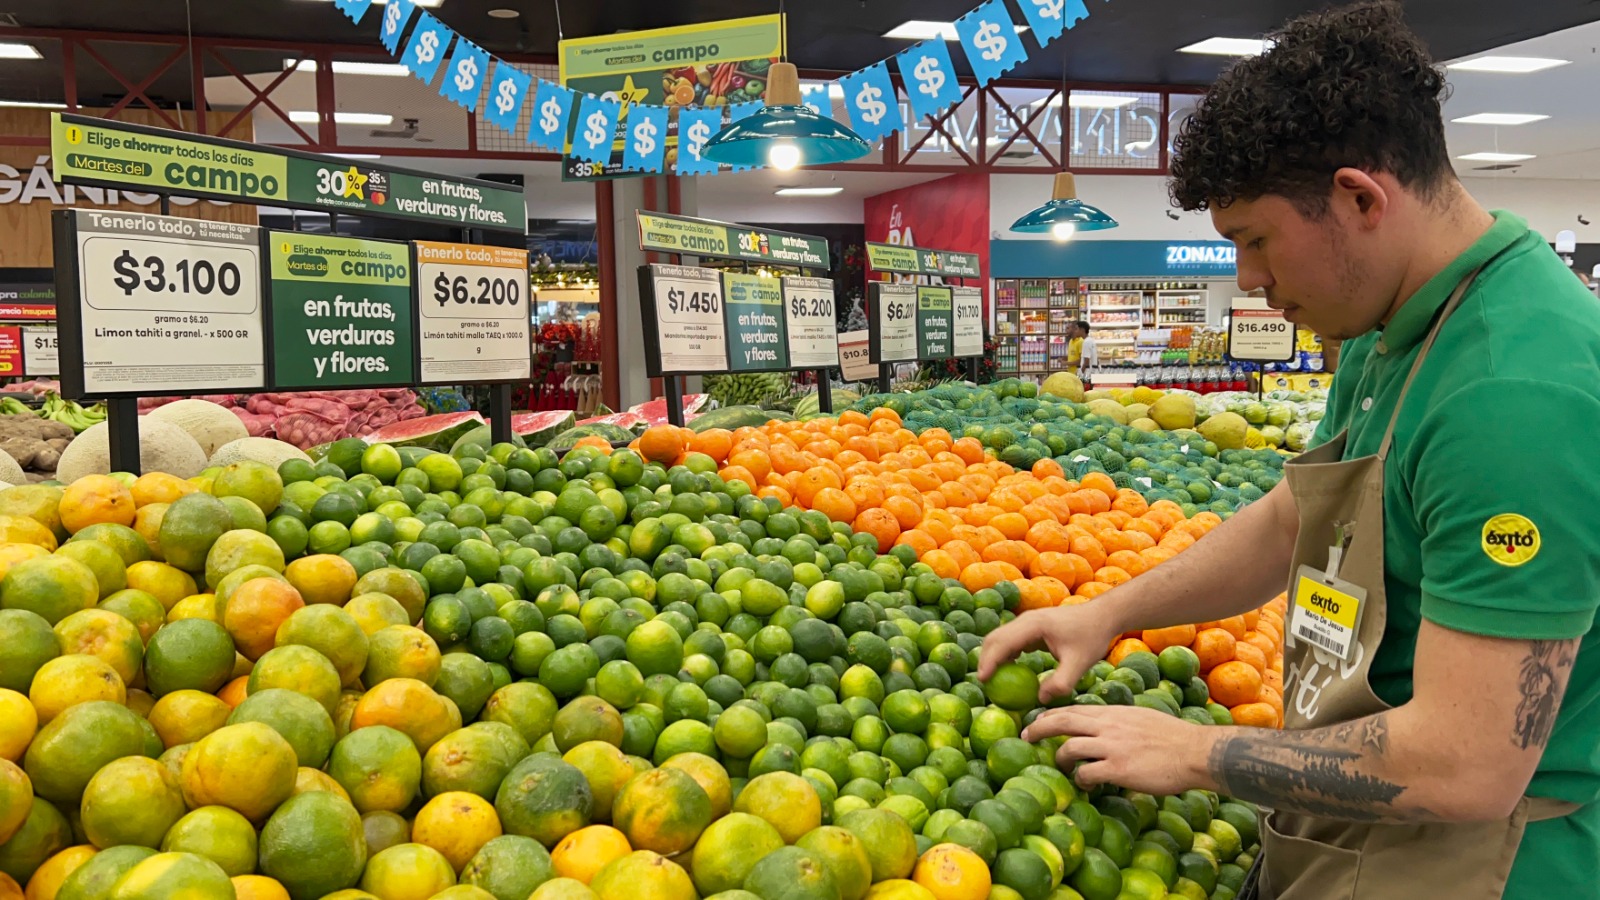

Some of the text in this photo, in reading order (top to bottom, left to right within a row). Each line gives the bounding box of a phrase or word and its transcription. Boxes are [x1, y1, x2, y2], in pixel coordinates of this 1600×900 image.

[652, 43, 719, 62] campo
[87, 131, 254, 167] Elige ahorrar todos los días
[74, 155, 145, 175] Martes del
[164, 162, 279, 197] campo
[422, 180, 483, 201] en frutas,
[396, 197, 507, 224] verduras y flores.
[89, 213, 196, 237] Tenerlo todo,
[199, 229, 245, 240] tú necesitas.
[209, 222, 228, 231] tener
[229, 224, 236, 232] lo
[237, 226, 250, 234] que
[294, 244, 314, 256] Elige
[315, 246, 346, 257] ahorrar
[348, 249, 367, 258] todos
[368, 250, 377, 259] los
[681, 234, 725, 253] campo
[417, 245, 493, 263] Tenerlo todo,
[772, 248, 799, 260] verduras
[113, 249, 241, 295] $3.100
[287, 260, 315, 270] Martes
[341, 260, 407, 282] campo
[434, 271, 519, 307] $6.200
[752, 289, 779, 303] campo
[304, 295, 396, 322] en frutas,
[668, 286, 718, 314] $7.450
[792, 295, 832, 318] $6.200
[154, 315, 181, 324] gramo
[189, 315, 208, 324] $6.20
[460, 321, 480, 329] gramo
[738, 311, 777, 327] en frutas,
[1237, 322, 1286, 333] $16.490
[95, 328, 133, 338] Limon
[135, 328, 163, 338] tahiti
[173, 329, 202, 340] granel.
[216, 330, 233, 339] 500
[235, 330, 248, 339] GR
[306, 324, 395, 345] verduras
[486, 332, 501, 340] TAEQ
[741, 329, 778, 343] verduras
[477, 346, 481, 354] g
[745, 346, 777, 364] y flores.
[843, 349, 868, 360] $10.8
[313, 351, 389, 378] y flores.
[1486, 530, 1534, 553] éxito
[1311, 592, 1340, 614] éxito
[1305, 609, 1344, 632] Mario De Jesus
